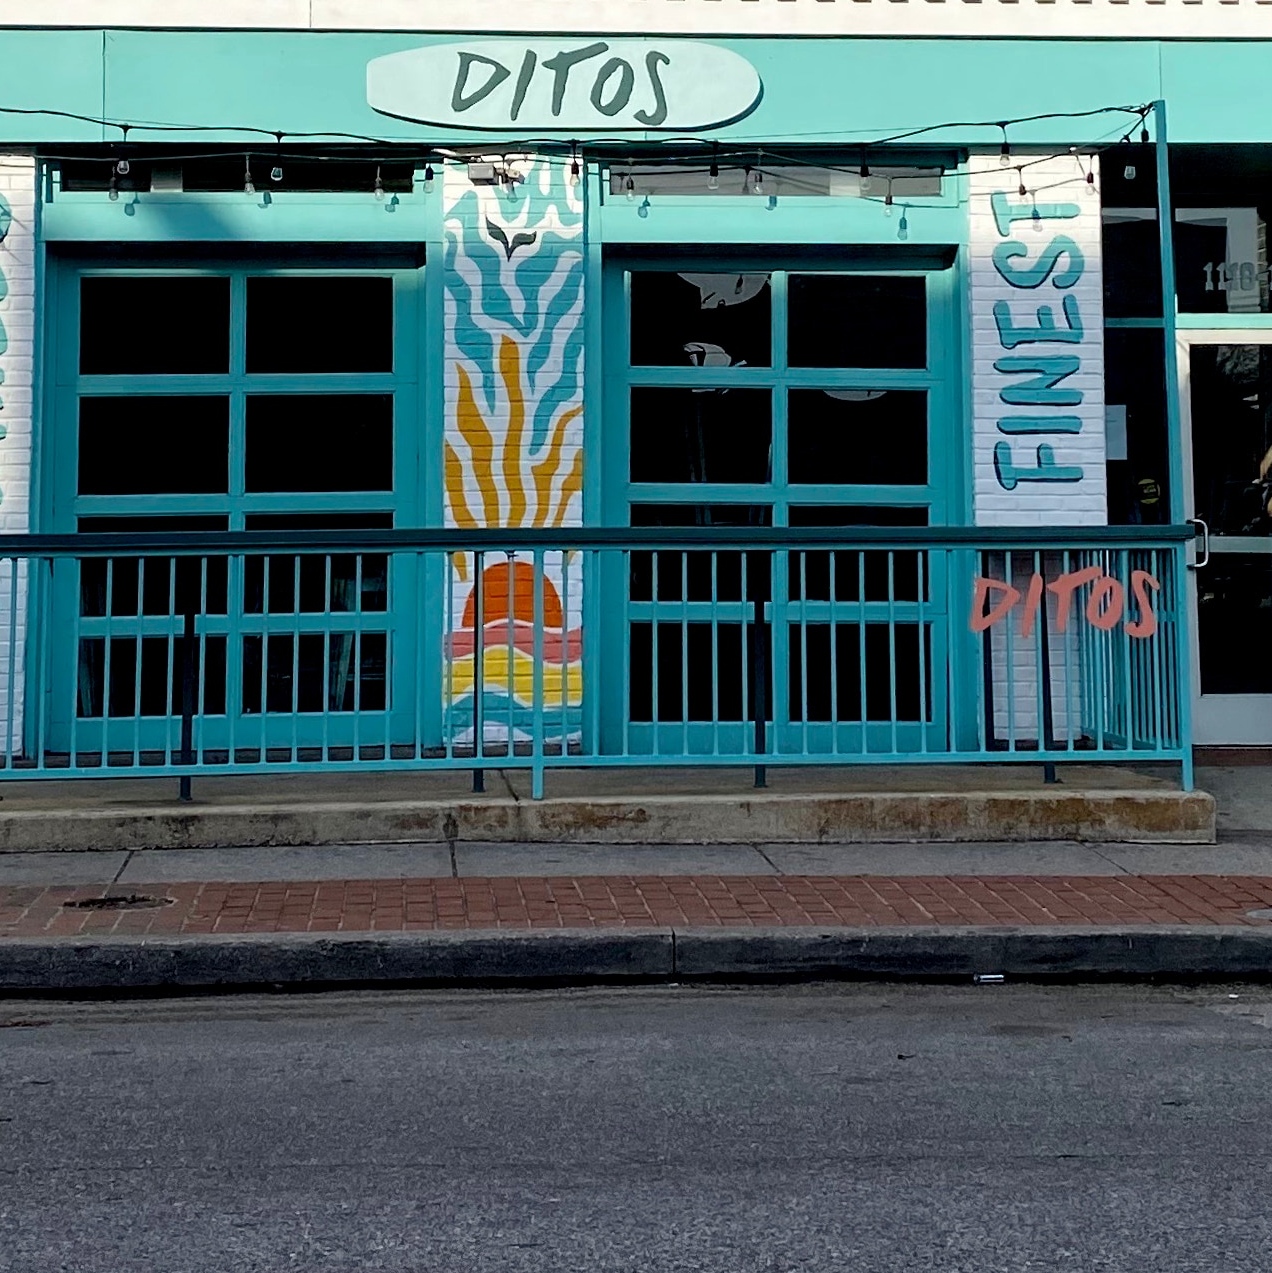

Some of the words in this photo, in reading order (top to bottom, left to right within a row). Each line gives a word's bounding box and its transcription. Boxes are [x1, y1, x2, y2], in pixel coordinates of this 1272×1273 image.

[451, 42, 670, 126] DITOS
[990, 190, 1085, 490] FINEST
[969, 566, 1161, 639] DITOS
